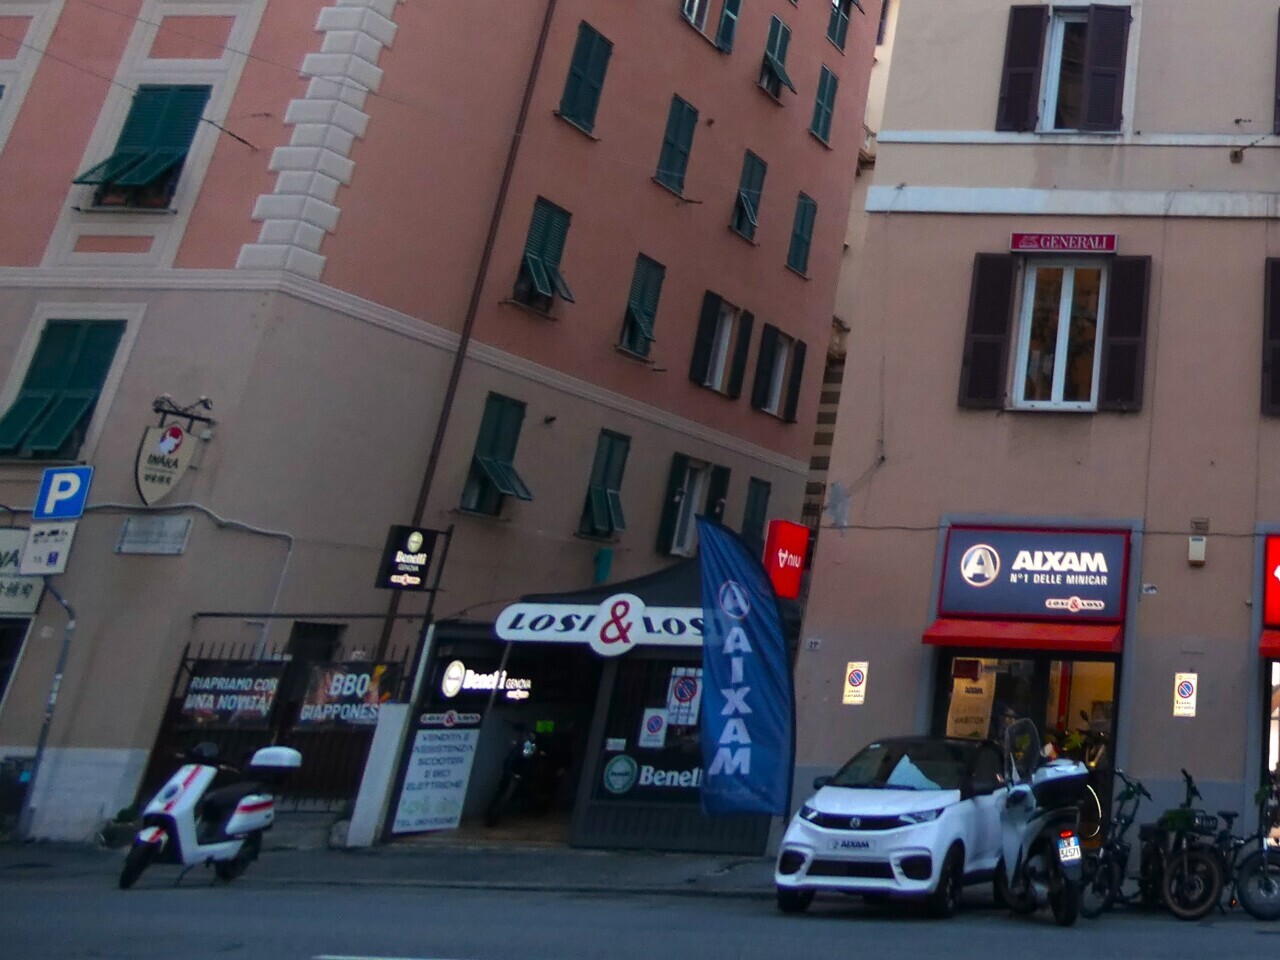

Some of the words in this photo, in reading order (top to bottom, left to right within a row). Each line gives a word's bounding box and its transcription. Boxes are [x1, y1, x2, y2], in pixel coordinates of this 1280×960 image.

[1041, 235, 1107, 249] GENERALI
[44, 472, 81, 515] P
[395, 550, 427, 566] Benelli
[1011, 550, 1108, 572] AIXAM
[1033, 573, 1063, 585] DELLE
[1066, 574, 1108, 586] MINICAR
[507, 613, 596, 633] LOSI
[600, 600, 633, 644] &
[642, 616, 704, 636] LOS
[328, 673, 372, 698] BBQ
[184, 693, 215, 710] UNA
[707, 626, 753, 776] AIXAM
[300, 703, 380, 721] GIAPPONES
[638, 764, 703, 788] Benel
[840, 840, 870, 849] AIXAM
